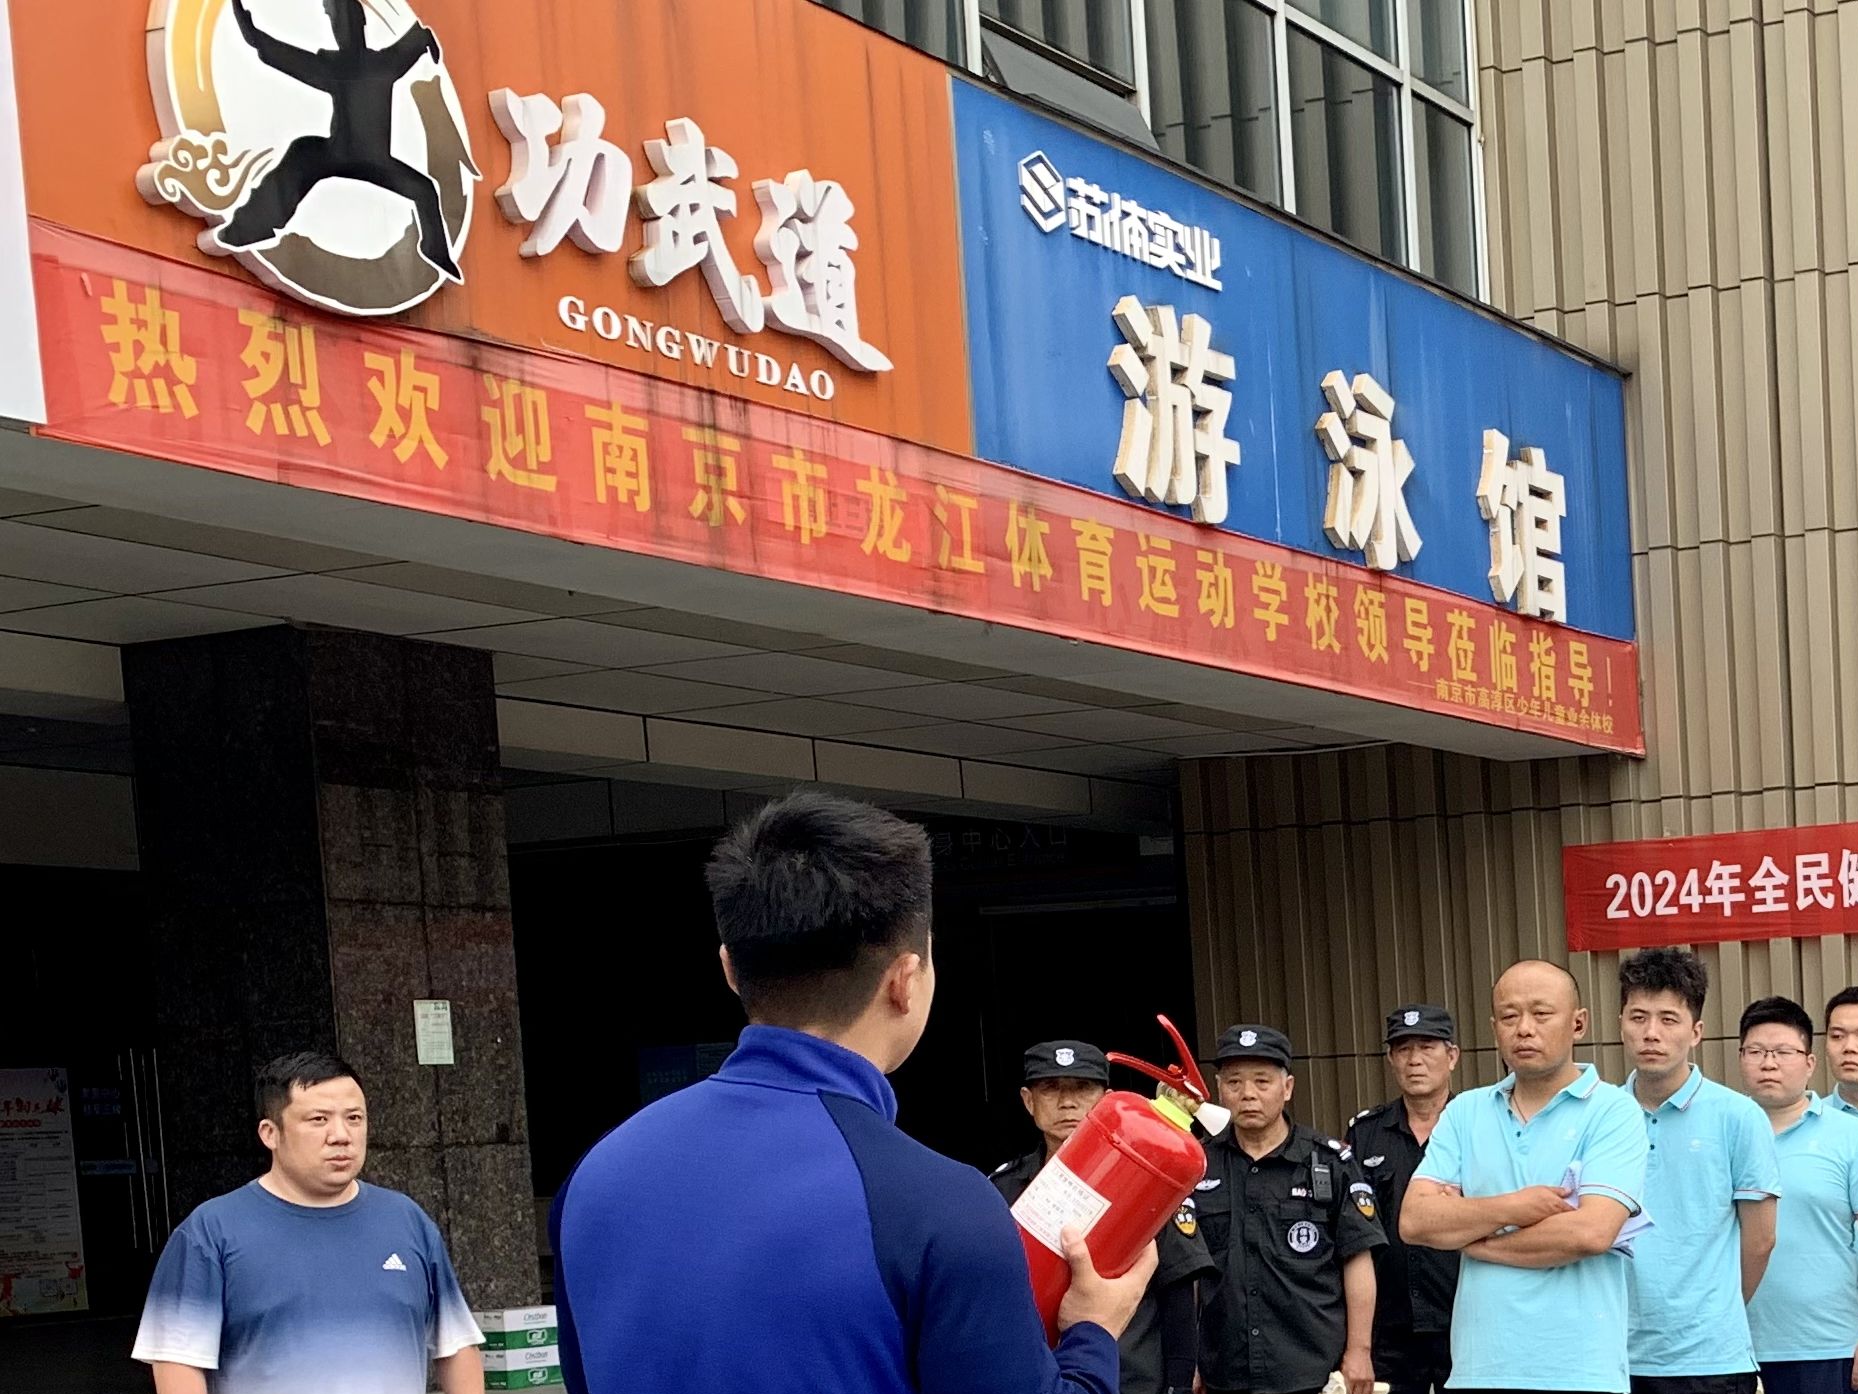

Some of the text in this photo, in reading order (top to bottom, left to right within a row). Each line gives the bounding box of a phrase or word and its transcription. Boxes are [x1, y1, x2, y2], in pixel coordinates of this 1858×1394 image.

[488, 86, 893, 373] 功武道
[1066, 175, 1222, 291] 苏体实业
[558, 295, 835, 401] GONGWUDAO
[1107, 294, 1567, 623] 游泳馆
